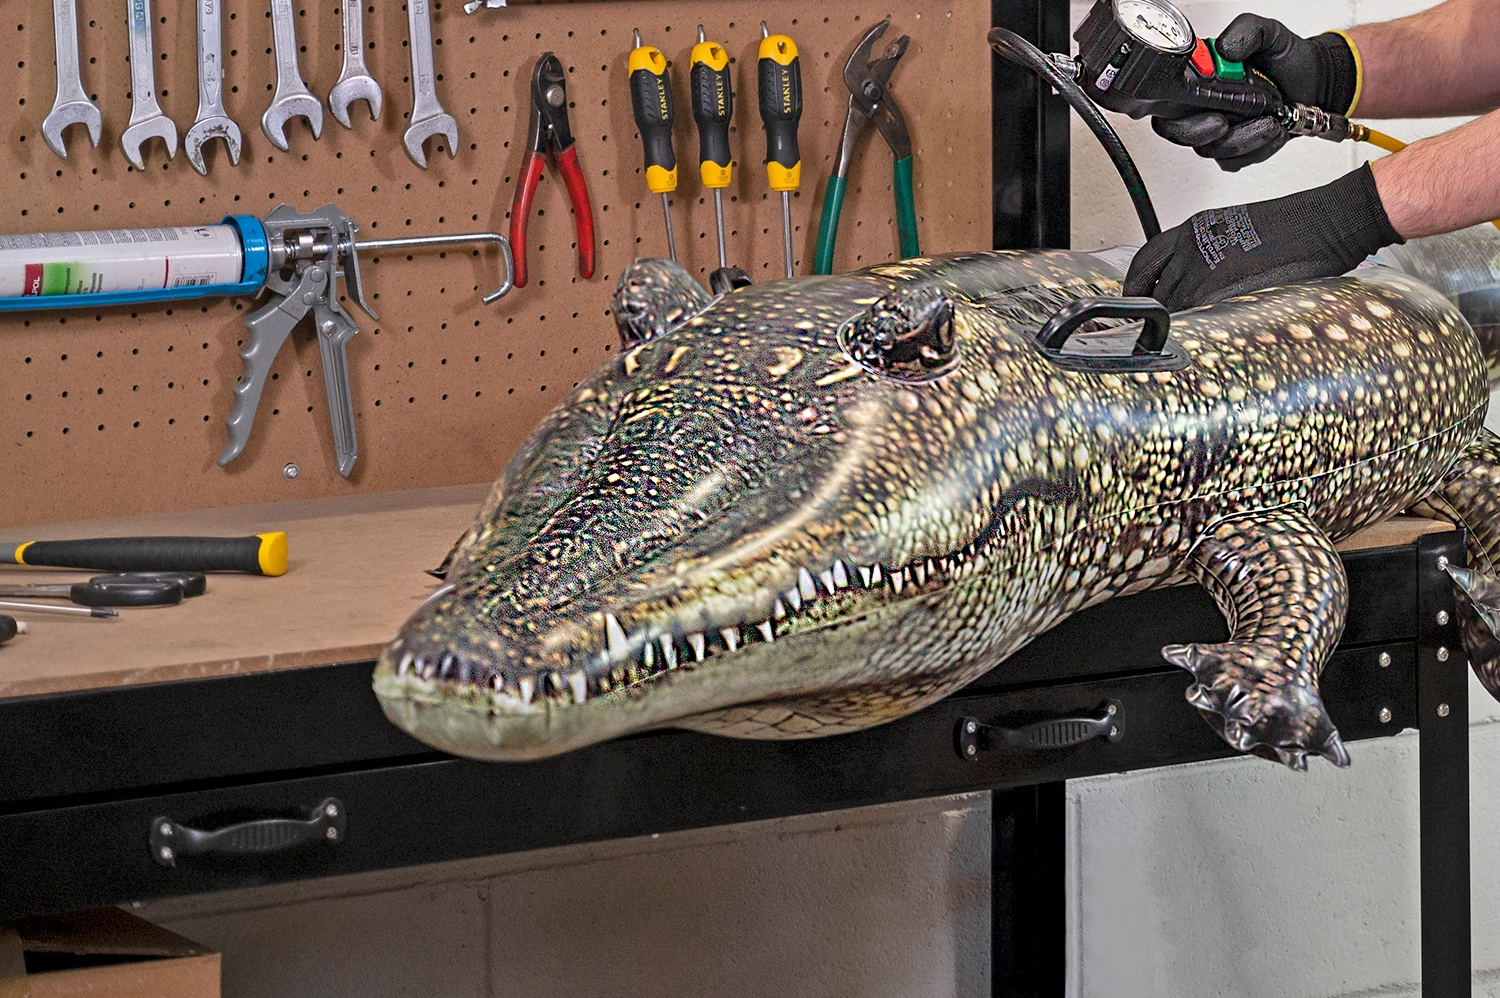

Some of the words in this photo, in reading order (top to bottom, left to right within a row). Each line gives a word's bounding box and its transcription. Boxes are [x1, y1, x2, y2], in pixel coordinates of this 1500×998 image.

[656, 78, 668, 120] STANLEY
[715, 74, 726, 116] STANLEY
[781, 68, 792, 114] STANLEY
